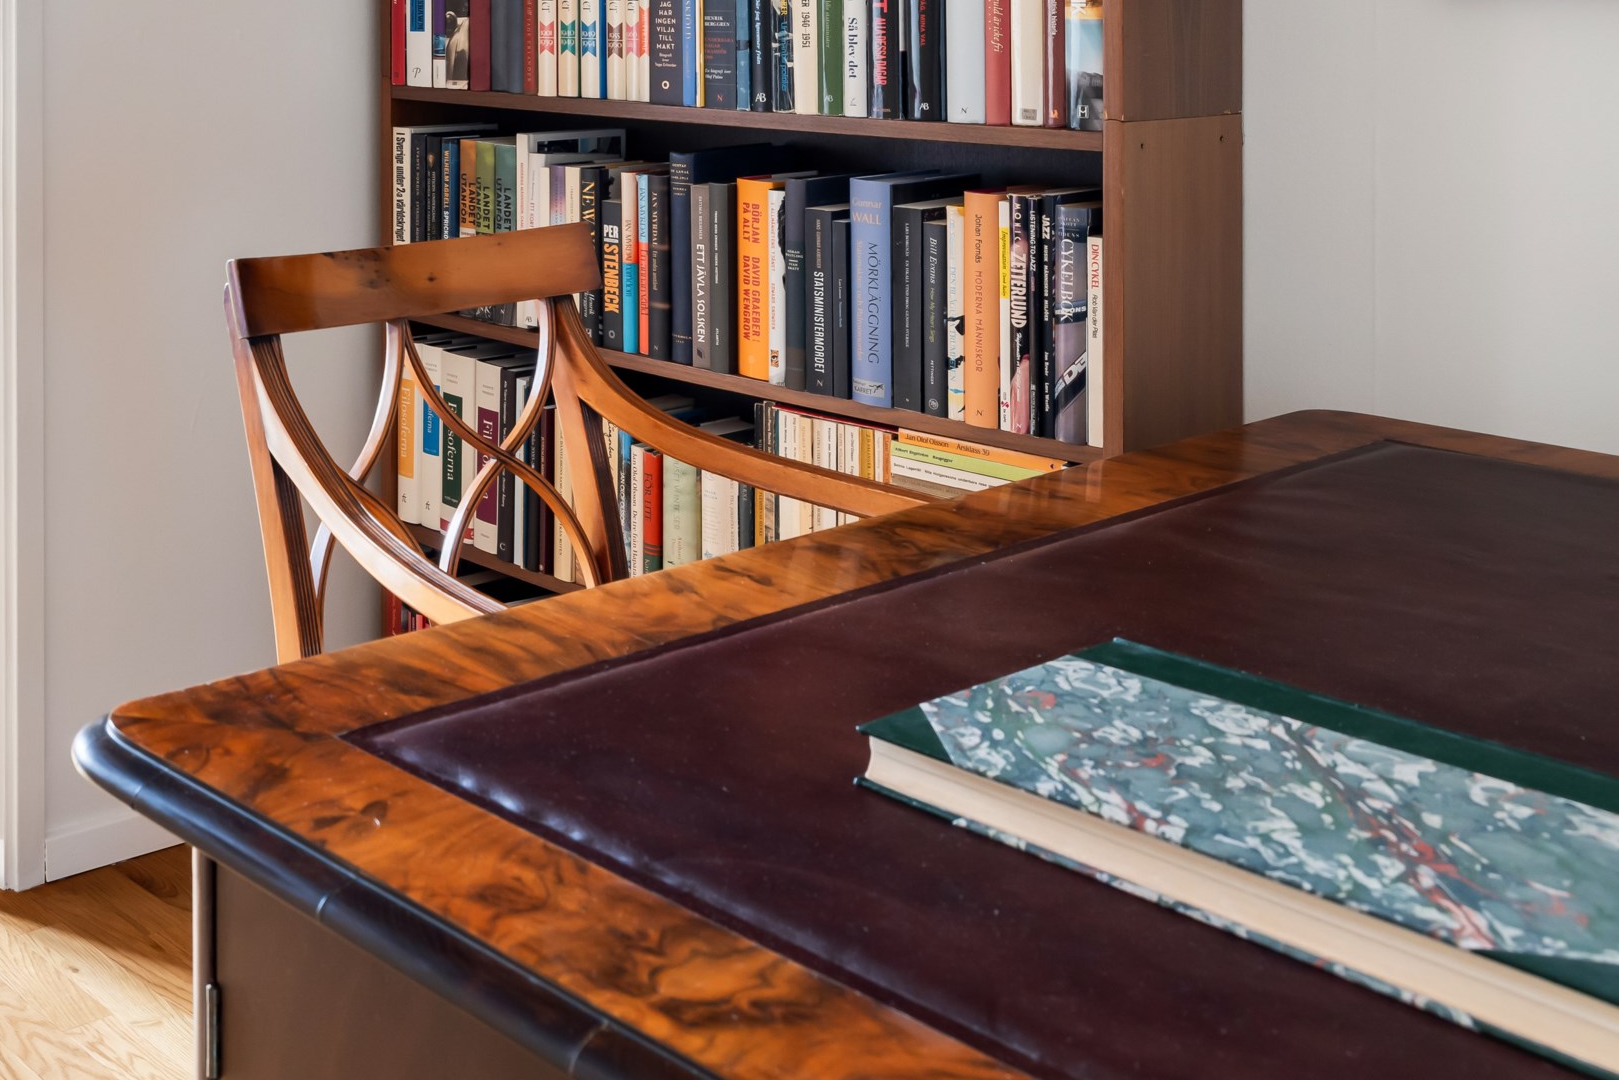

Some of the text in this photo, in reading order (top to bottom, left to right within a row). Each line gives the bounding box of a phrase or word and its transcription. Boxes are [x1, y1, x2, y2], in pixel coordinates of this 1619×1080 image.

[847, 16, 860, 32] Så
[848, 33, 859, 58] blev
[848, 60, 859, 79] det
[876, 60, 888, 85] DAGAR
[468, 182, 476, 226] LANDET
[482, 186, 491, 230] LANDET
[503, 187, 512, 231] LANDET
[582, 180, 596, 223] NEW
[651, 191, 659, 208] JAN
[851, 212, 882, 225] WALL
[603, 224, 619, 238] PER
[604, 242, 620, 314] STENBECK
[742, 202, 752, 341] PÅ ALLT DAVID WENGROW
[751, 203, 762, 337] BÖRJAN DAVID GRAEBER
[1010, 252, 1027, 331] ZETTERLUND
[1060, 238, 1075, 322] CYKELBOK
[696, 243, 707, 343] ETT JÄVLA SOLSKEN
[867, 241, 884, 364] MÖRKLÄGGNING
[974, 214, 984, 373] Johan Fornäs MODERNA MÄNNISKOR
[813, 271, 825, 374] STATSMINISTERMORDET
[400, 386, 411, 458] Filosoferna
[631, 453, 639, 466] Jan
[643, 472, 653, 497] FÖR
